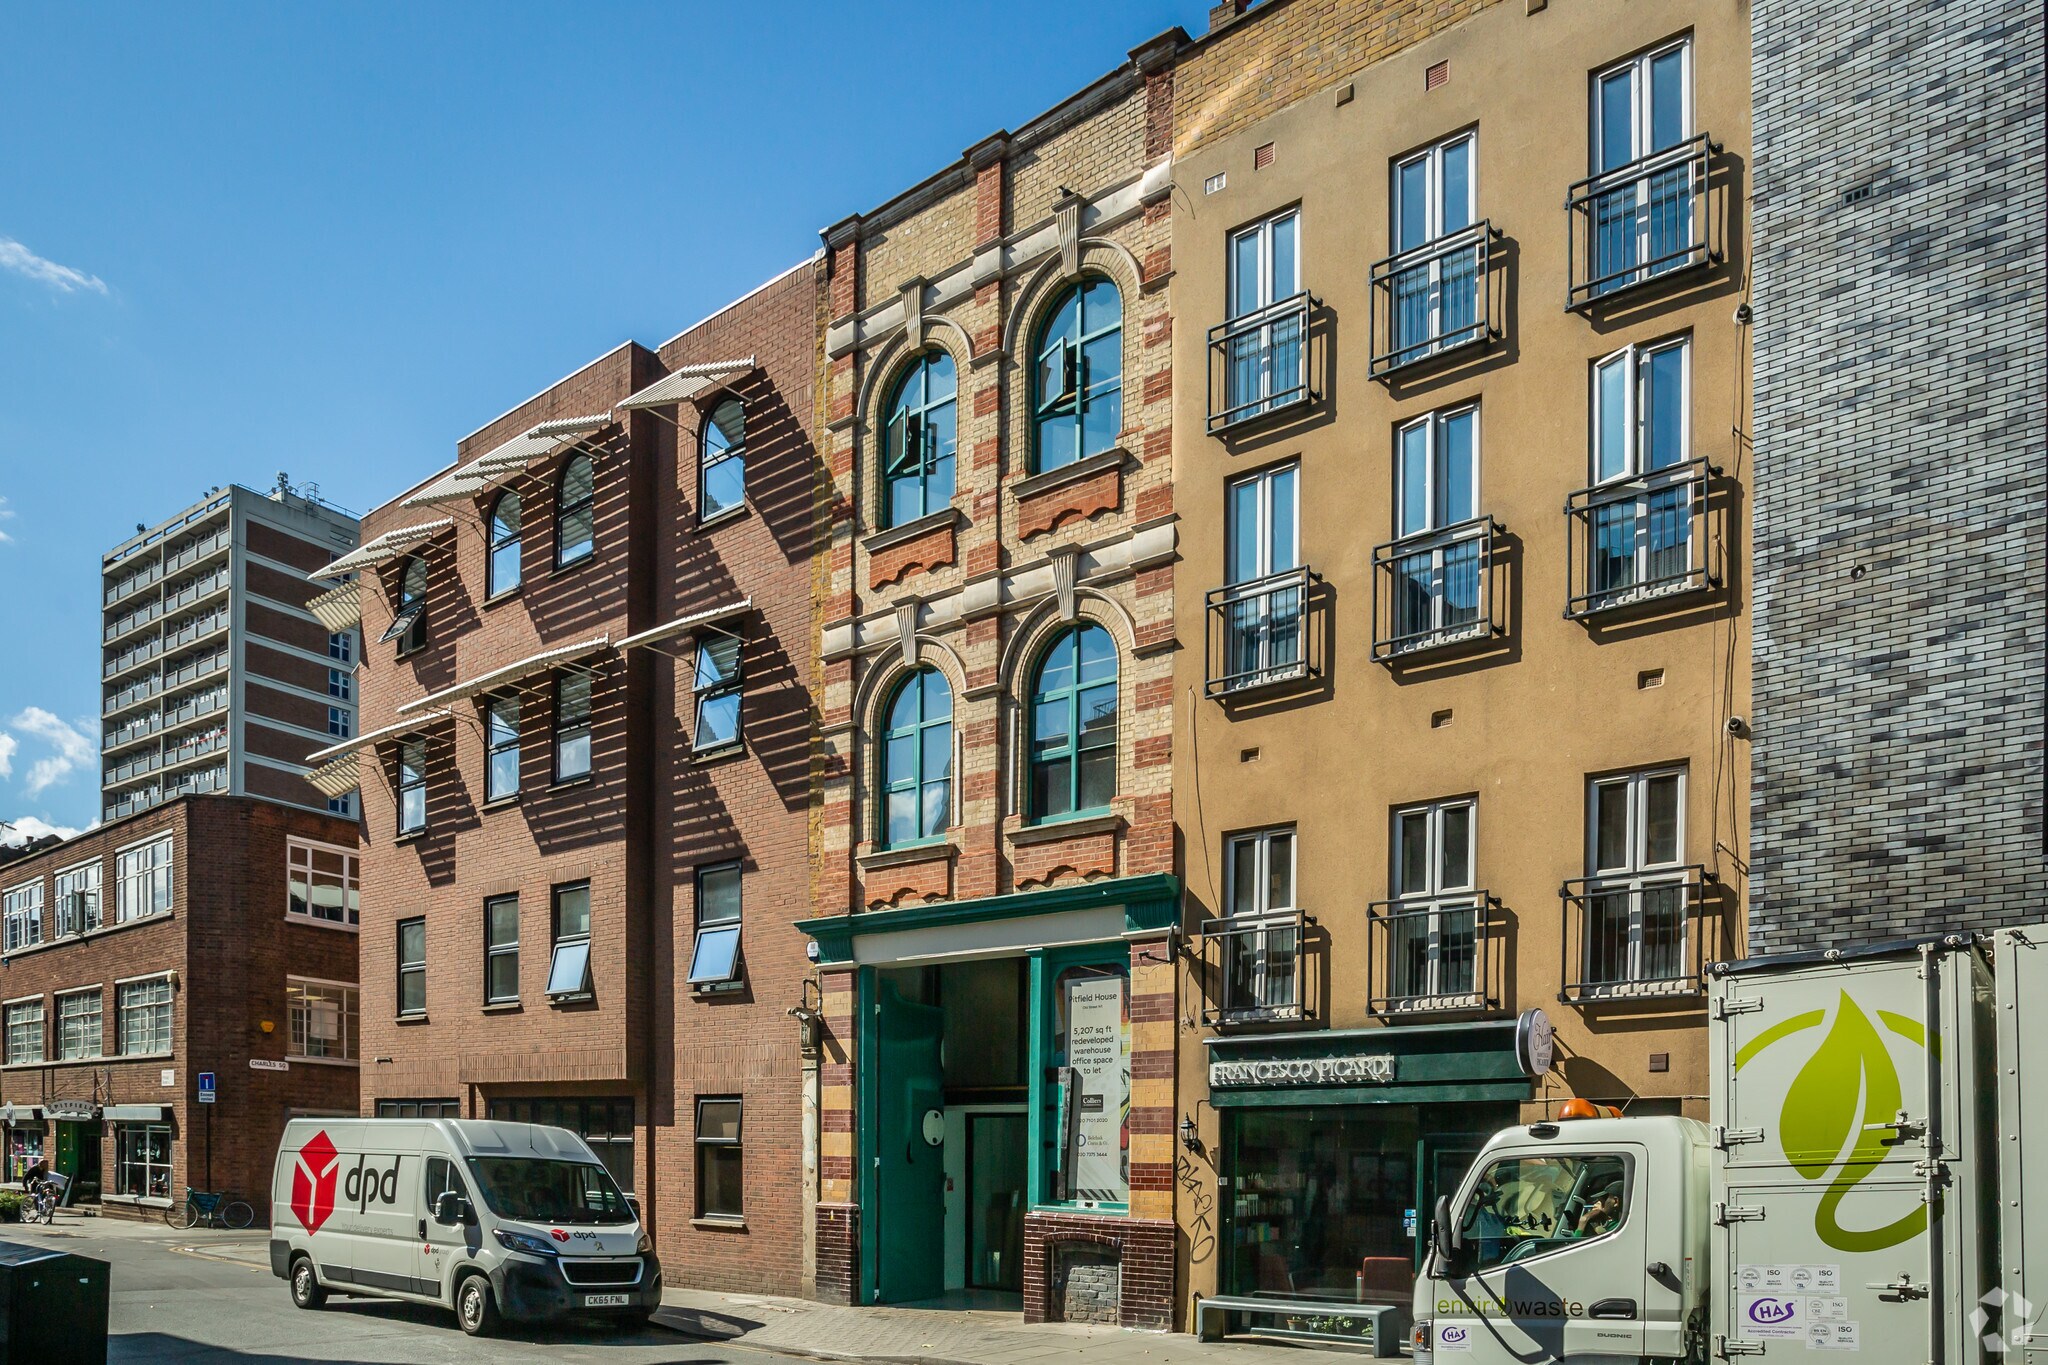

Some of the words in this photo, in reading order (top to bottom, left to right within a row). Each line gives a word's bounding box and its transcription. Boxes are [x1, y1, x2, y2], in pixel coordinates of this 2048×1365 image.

[1094, 993, 1117, 1001] House
[1074, 1026, 1094, 1036] 5,207
[1072, 1036, 1114, 1045] redeveloped
[1074, 1046, 1112, 1054] warehouse
[1212, 1062, 1314, 1081] FRANCESCO
[1319, 1058, 1392, 1079] PICARDI
[54, 1102, 93, 1110] PITFIELD
[344, 1154, 402, 1215] dpd
[574, 1230, 596, 1240] dpd
[588, 1296, 608, 1304] CK65
[610, 1296, 624, 1304] FNL
[1748, 1298, 1794, 1324] CHAS
[1442, 1326, 1466, 1342] CHAS
